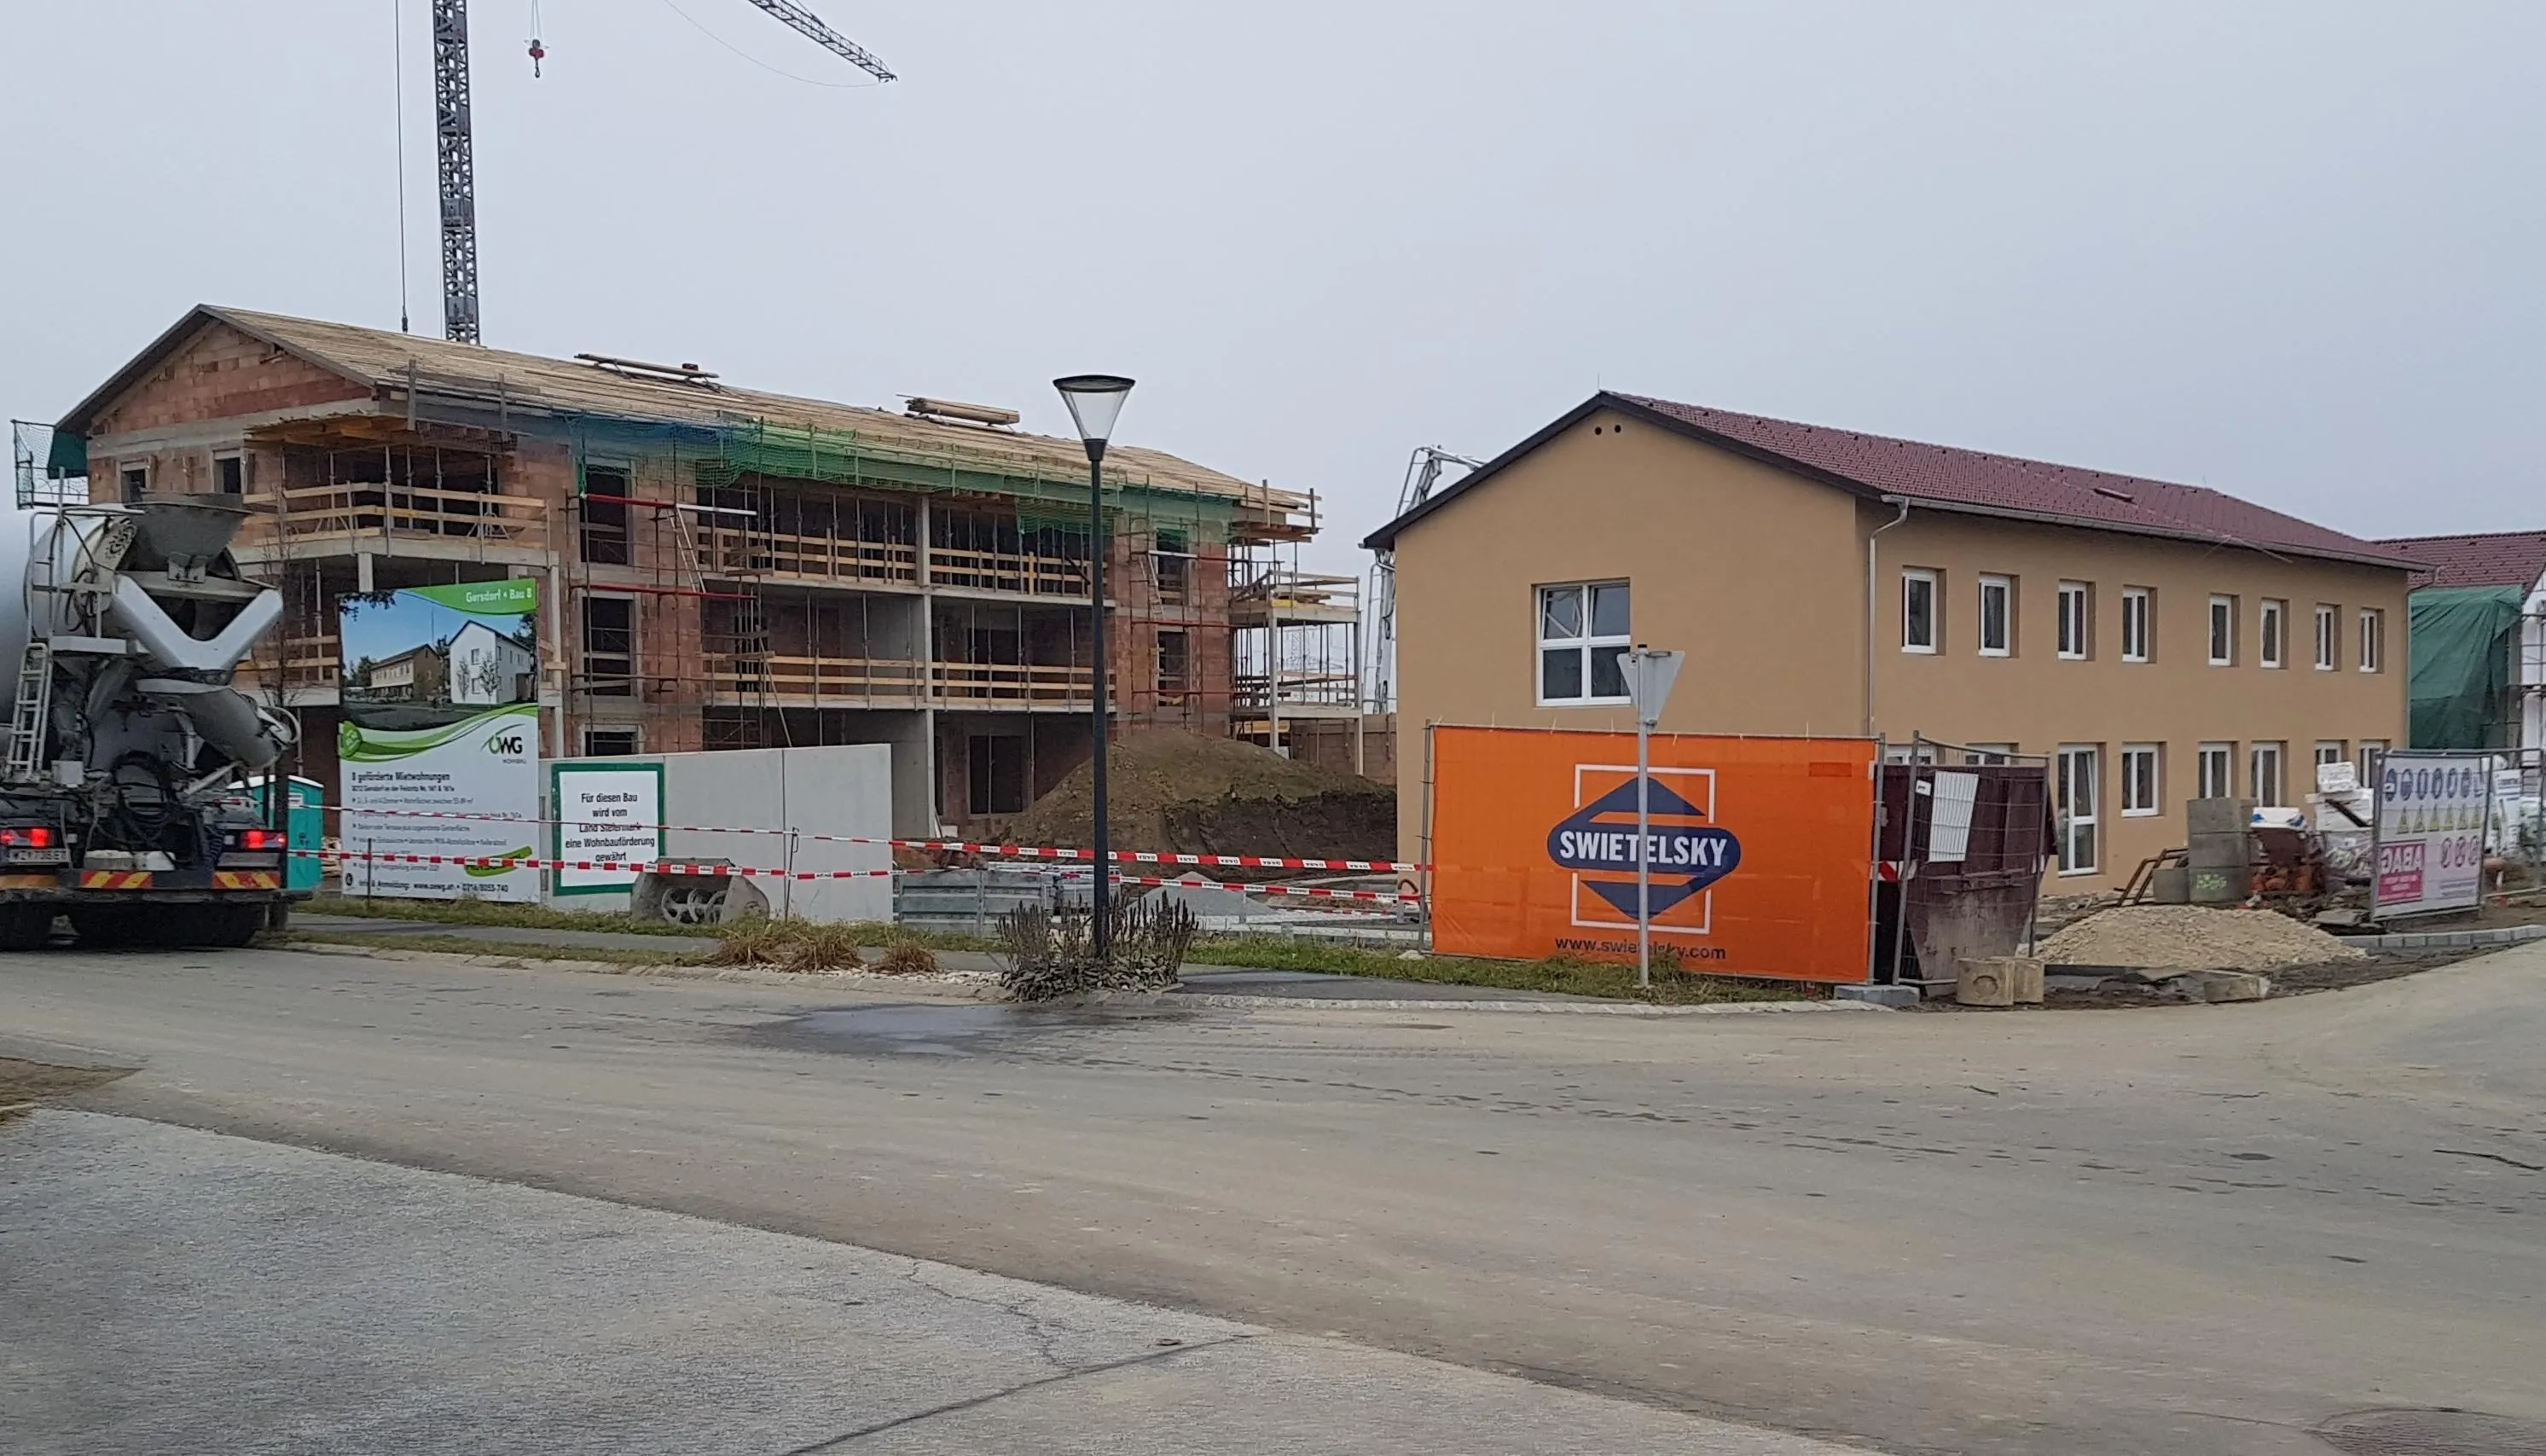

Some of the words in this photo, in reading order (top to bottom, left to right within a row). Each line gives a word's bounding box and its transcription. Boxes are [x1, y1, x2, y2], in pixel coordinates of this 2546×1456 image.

[466, 589, 502, 603] Gersdorf
[509, 589, 525, 600] Bau
[581, 792, 594, 803] Für
[596, 792, 621, 803] diesen
[623, 792, 638, 802] Bau
[592, 808, 609, 817] wird
[612, 809, 628, 817] vom
[565, 839, 583, 849] eine
[583, 836, 655, 848] Wohnbauförderung
[1559, 830, 1728, 867] SWIETELSKY
[1555, 937, 1726, 960] www.swieelsky.com
